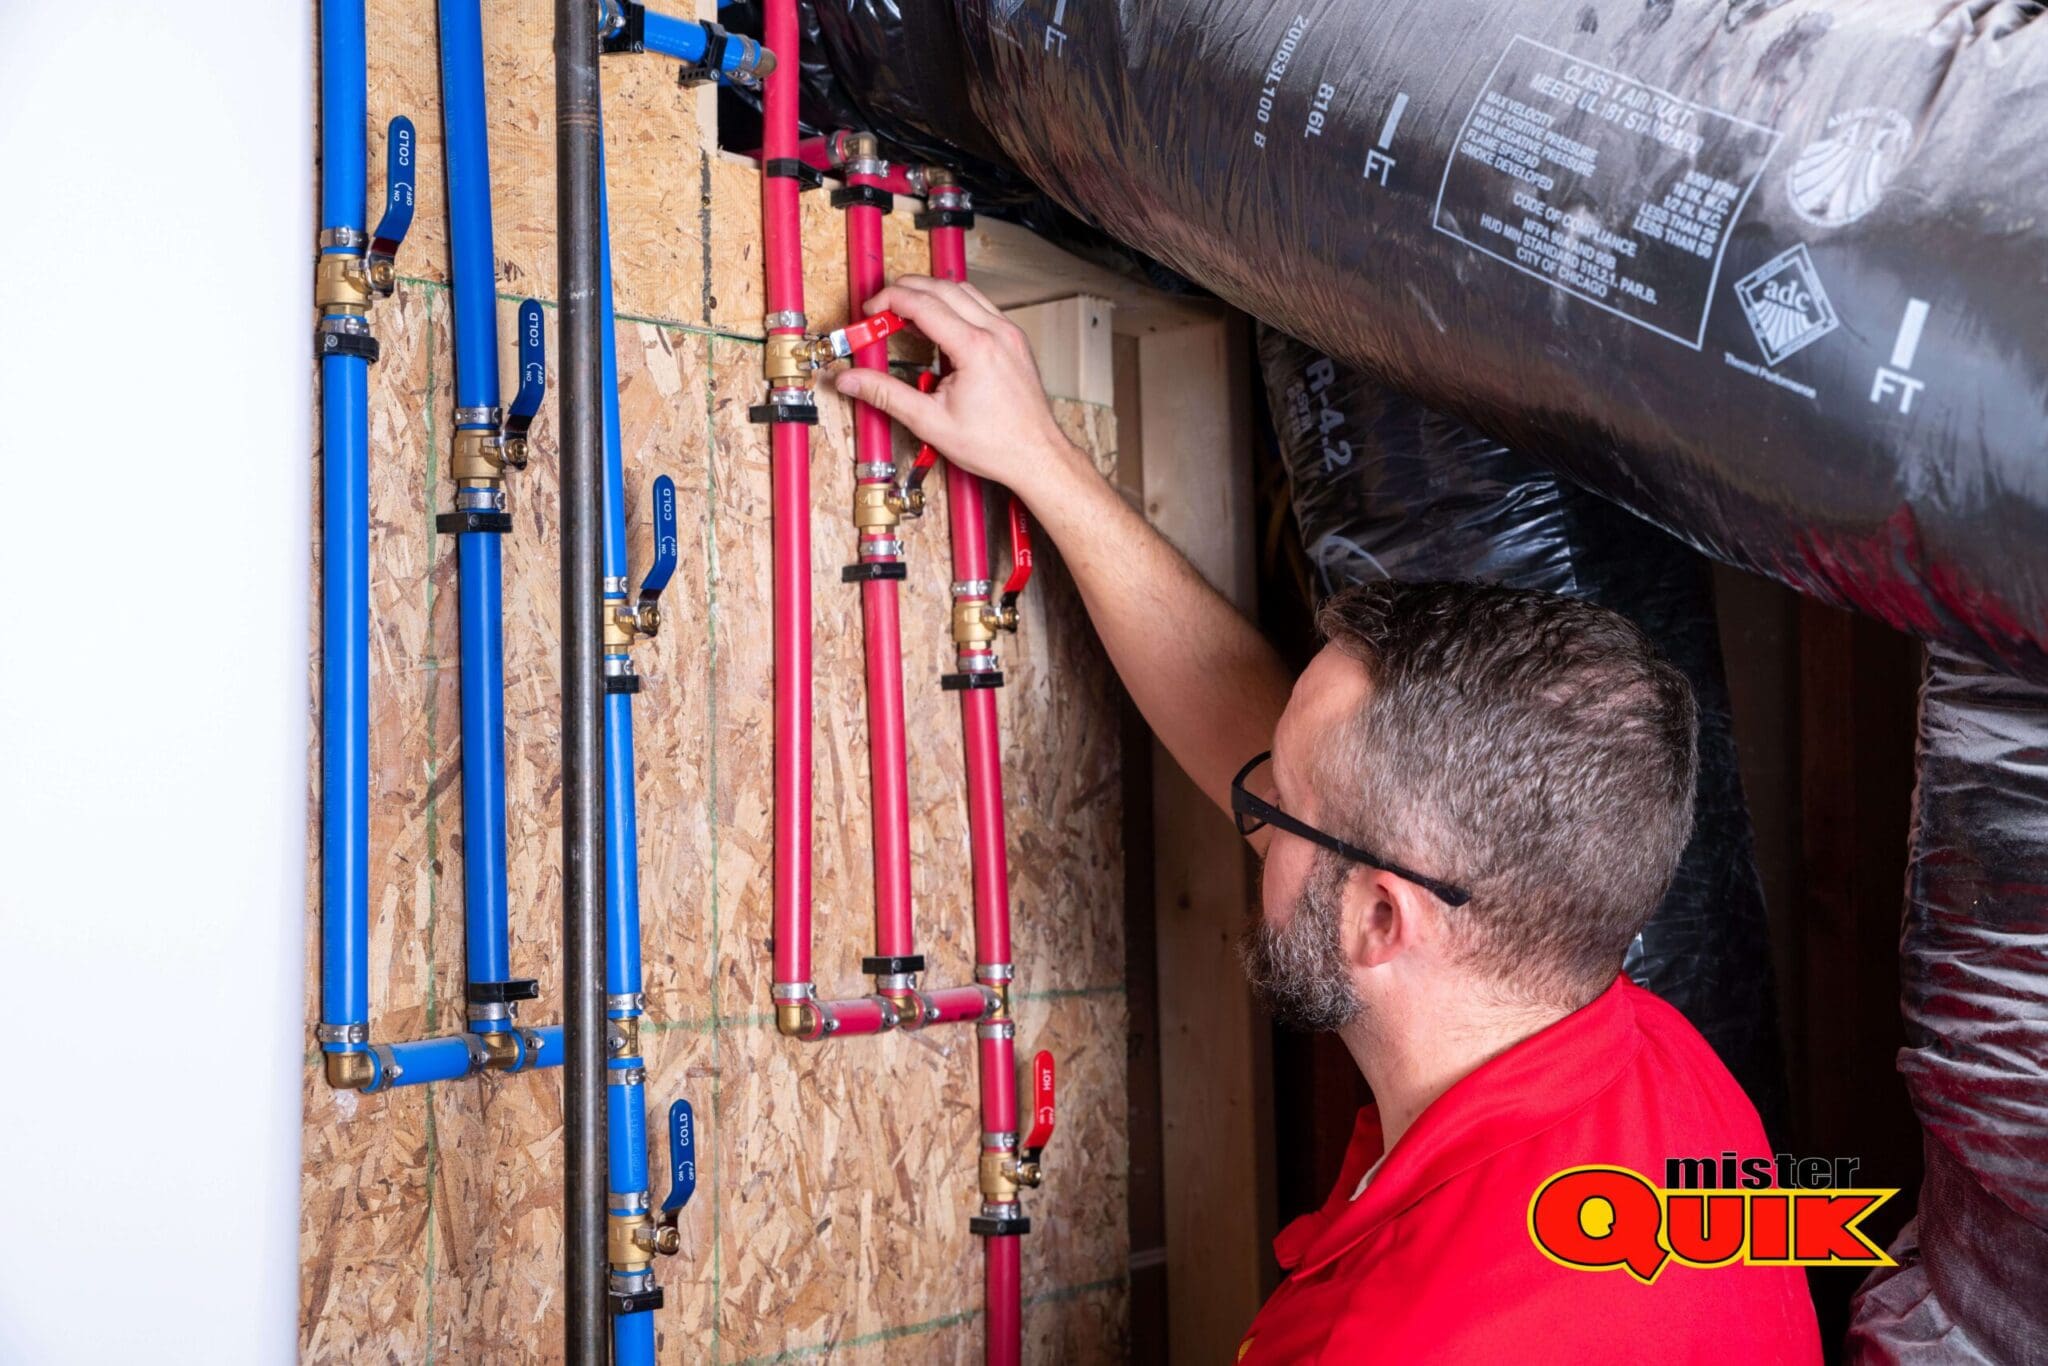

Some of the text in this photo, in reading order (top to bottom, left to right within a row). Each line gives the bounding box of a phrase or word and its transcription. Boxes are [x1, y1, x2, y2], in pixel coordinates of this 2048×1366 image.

[1044, 25, 1067, 58] FT
[1529, 73, 1581, 105] MEETS
[1577, 92, 1600, 114] UL
[1600, 101, 1625, 122] 181
[1564, 64, 1613, 95] CLASS
[1621, 87, 1651, 110] AIR
[1486, 90, 1556, 126] MAX VELOCITY
[399, 130, 409, 166] COLD
[1466, 128, 1540, 169] FLAME SPREAD
[1472, 115, 1597, 178] MAX NEGATIVE PRESSURE
[1478, 103, 1599, 163] MAX POSITIVE PRESSURE
[1363, 148, 1396, 187] FT
[1460, 141, 1554, 191] SMOKE DEVELOPED
[393, 190, 400, 202] ON
[1513, 192, 1638, 258] CODE OF COMPLIANCE
[1522, 217, 1549, 241] NFPA
[1570, 239, 1595, 260] AND
[1632, 215, 1664, 239] LESS
[1664, 227, 1698, 252] THAN
[1639, 202, 1670, 224] LESS
[1669, 213, 1703, 237] THAN
[1480, 213, 1503, 234] HUD
[1522, 234, 1579, 269] STANDARD
[1516, 247, 1607, 298] CITY OF CHICAGO
[1763, 279, 1810, 312] adc
[529, 312, 539, 347] COLD
[526, 370, 532, 382] ON
[1870, 366, 1925, 414] FT
[1306, 357, 1352, 472] R-4.2
[663, 488, 672, 521] COLD
[1042, 1068, 1052, 1091] HOT
[680, 1113, 688, 1146] COLD
